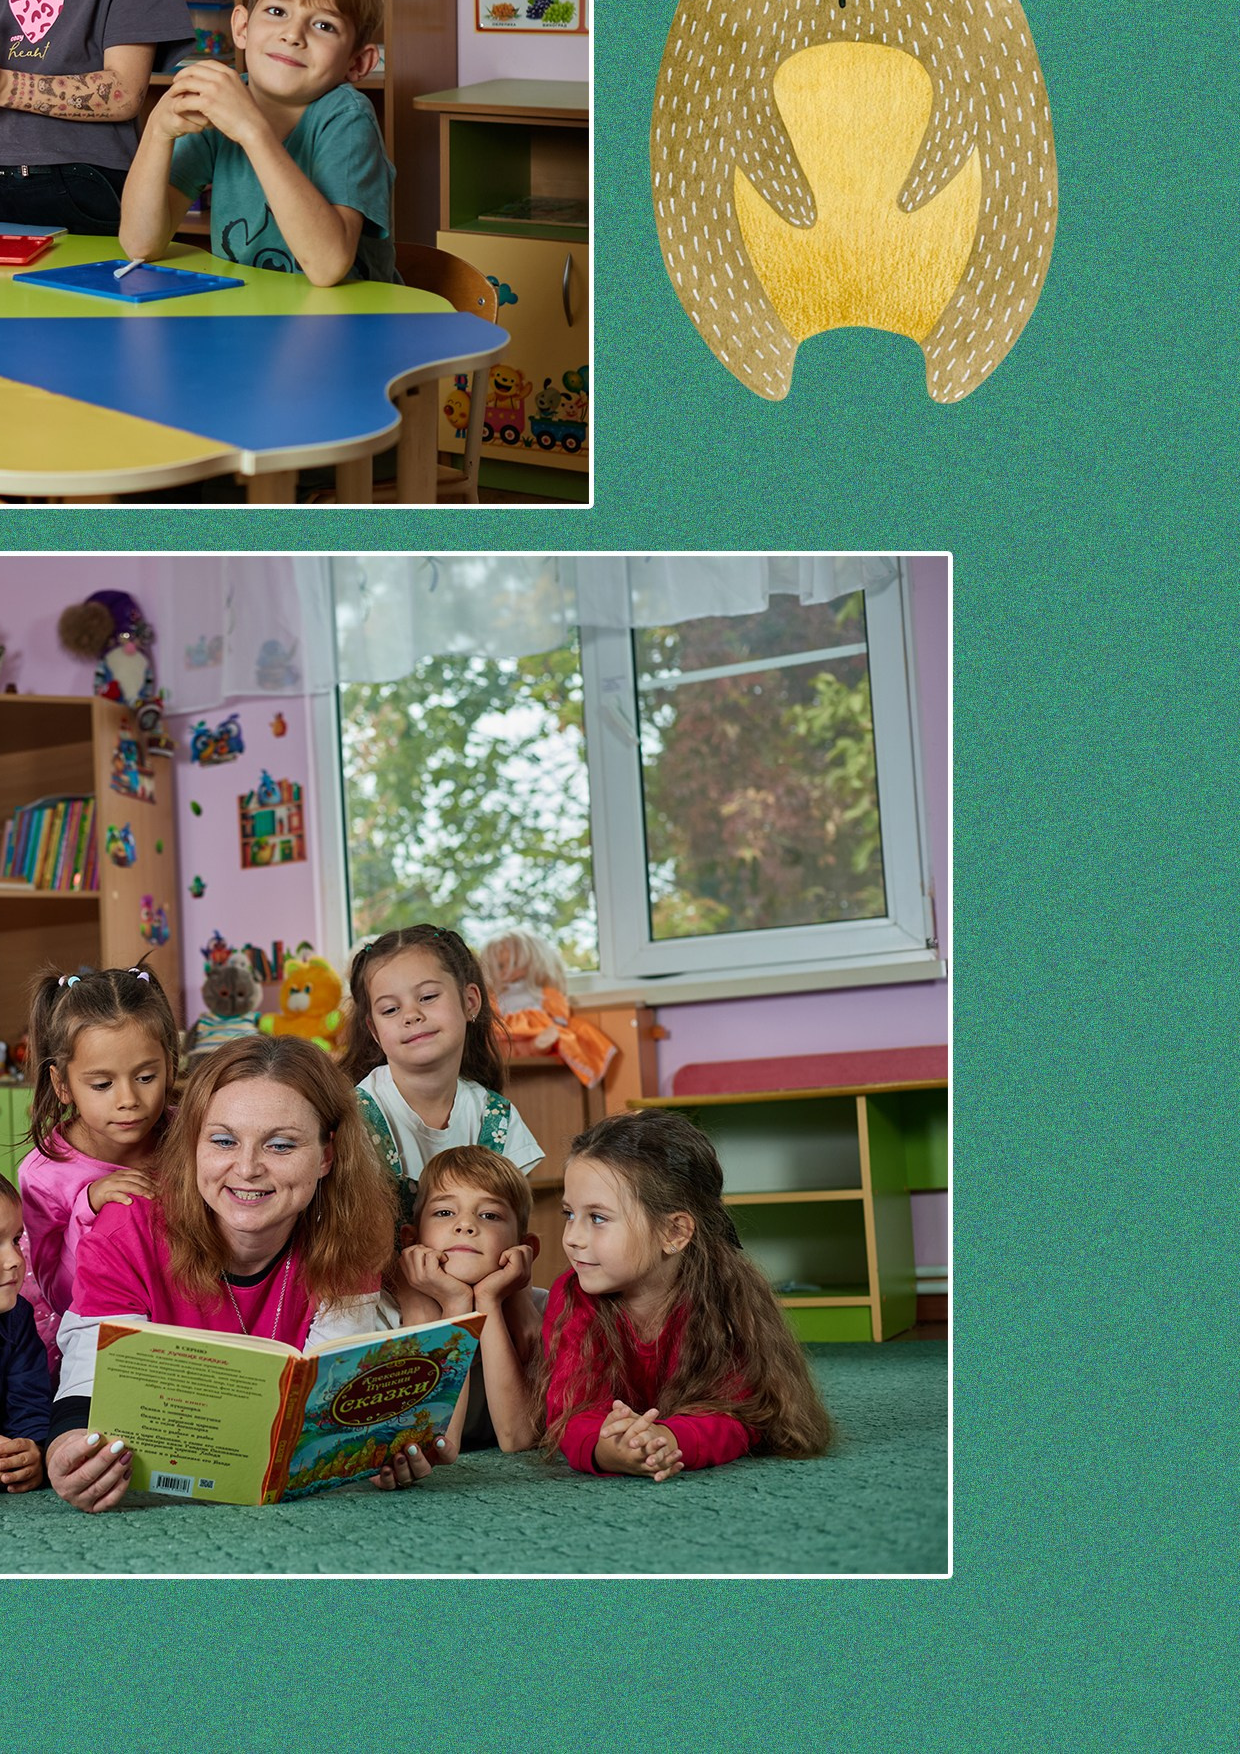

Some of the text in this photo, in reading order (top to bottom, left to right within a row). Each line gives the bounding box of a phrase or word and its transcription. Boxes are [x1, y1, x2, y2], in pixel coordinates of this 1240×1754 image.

[8, 41, 50, 60] heart
[362, 1364, 421, 1386] Александр
[366, 1376, 412, 1394] Пушкин
